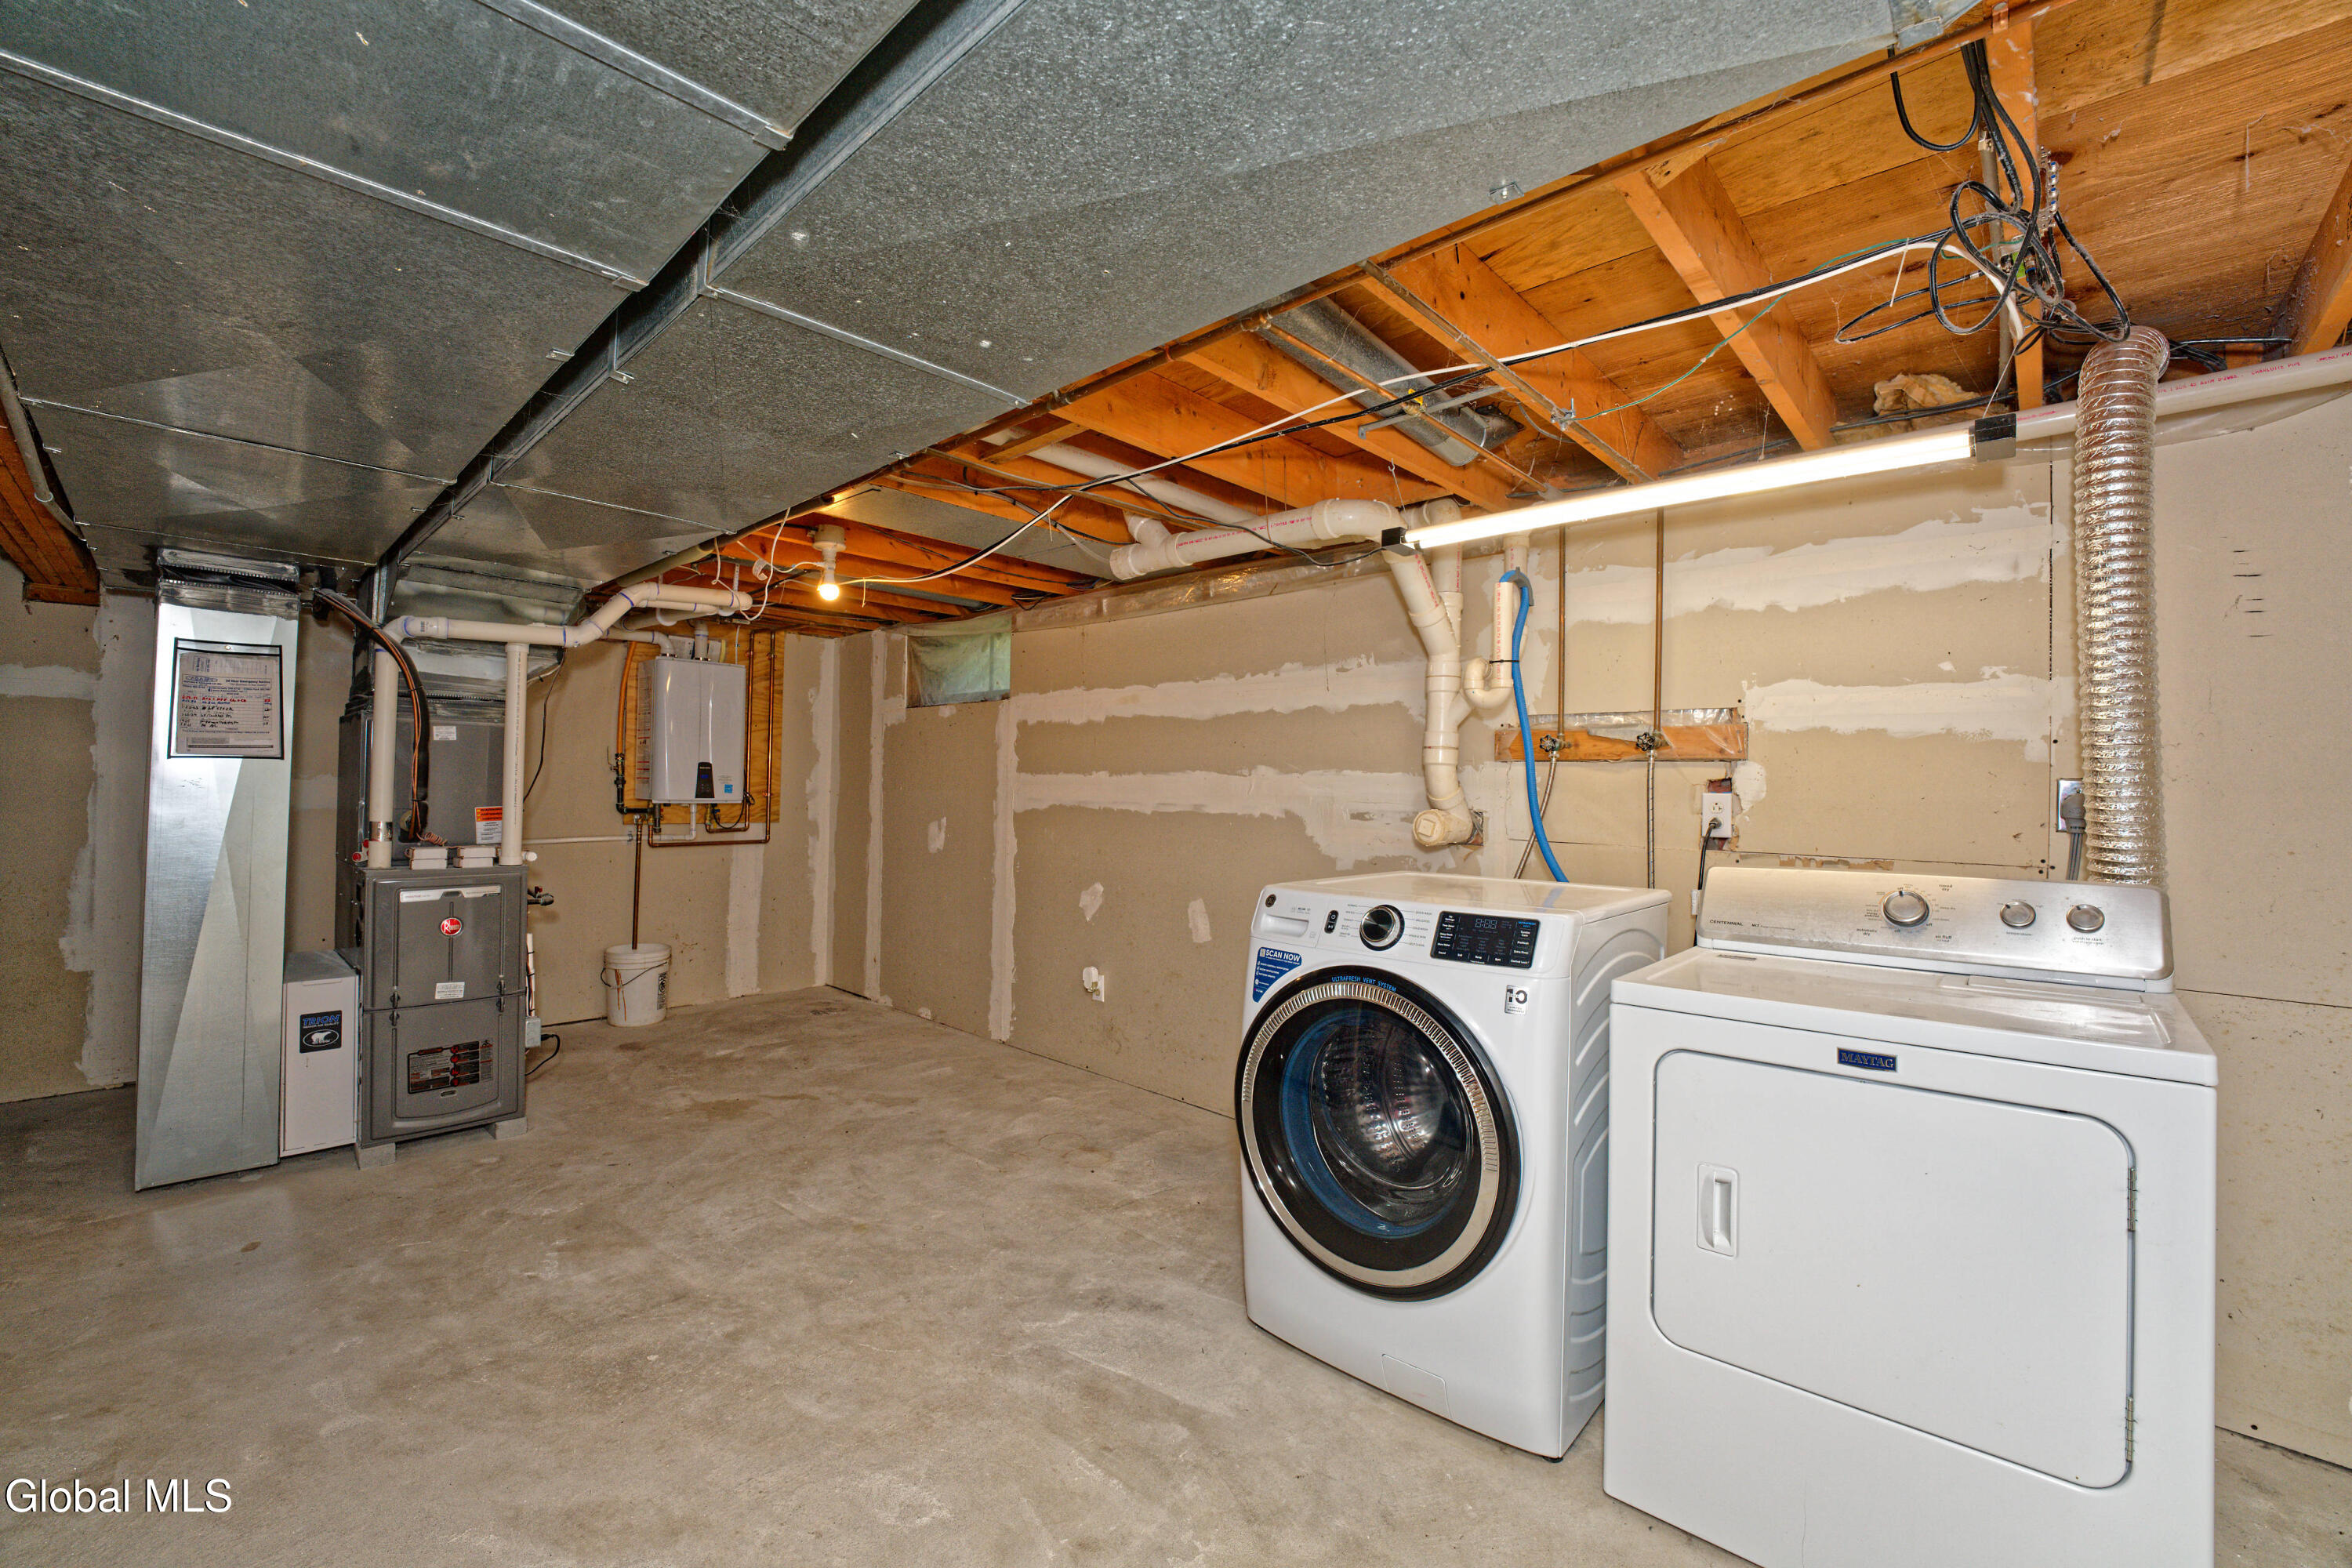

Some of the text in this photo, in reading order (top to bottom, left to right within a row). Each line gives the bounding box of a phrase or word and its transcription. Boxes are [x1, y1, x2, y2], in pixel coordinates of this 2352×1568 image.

[1265, 949, 1282, 959] SCAN
[1283, 953, 1301, 962] NOW
[1377, 981, 1396, 993] SYSTEM
[303, 1014, 340, 1026] TRION
[1841, 1051, 1895, 1069] MAYTAG
